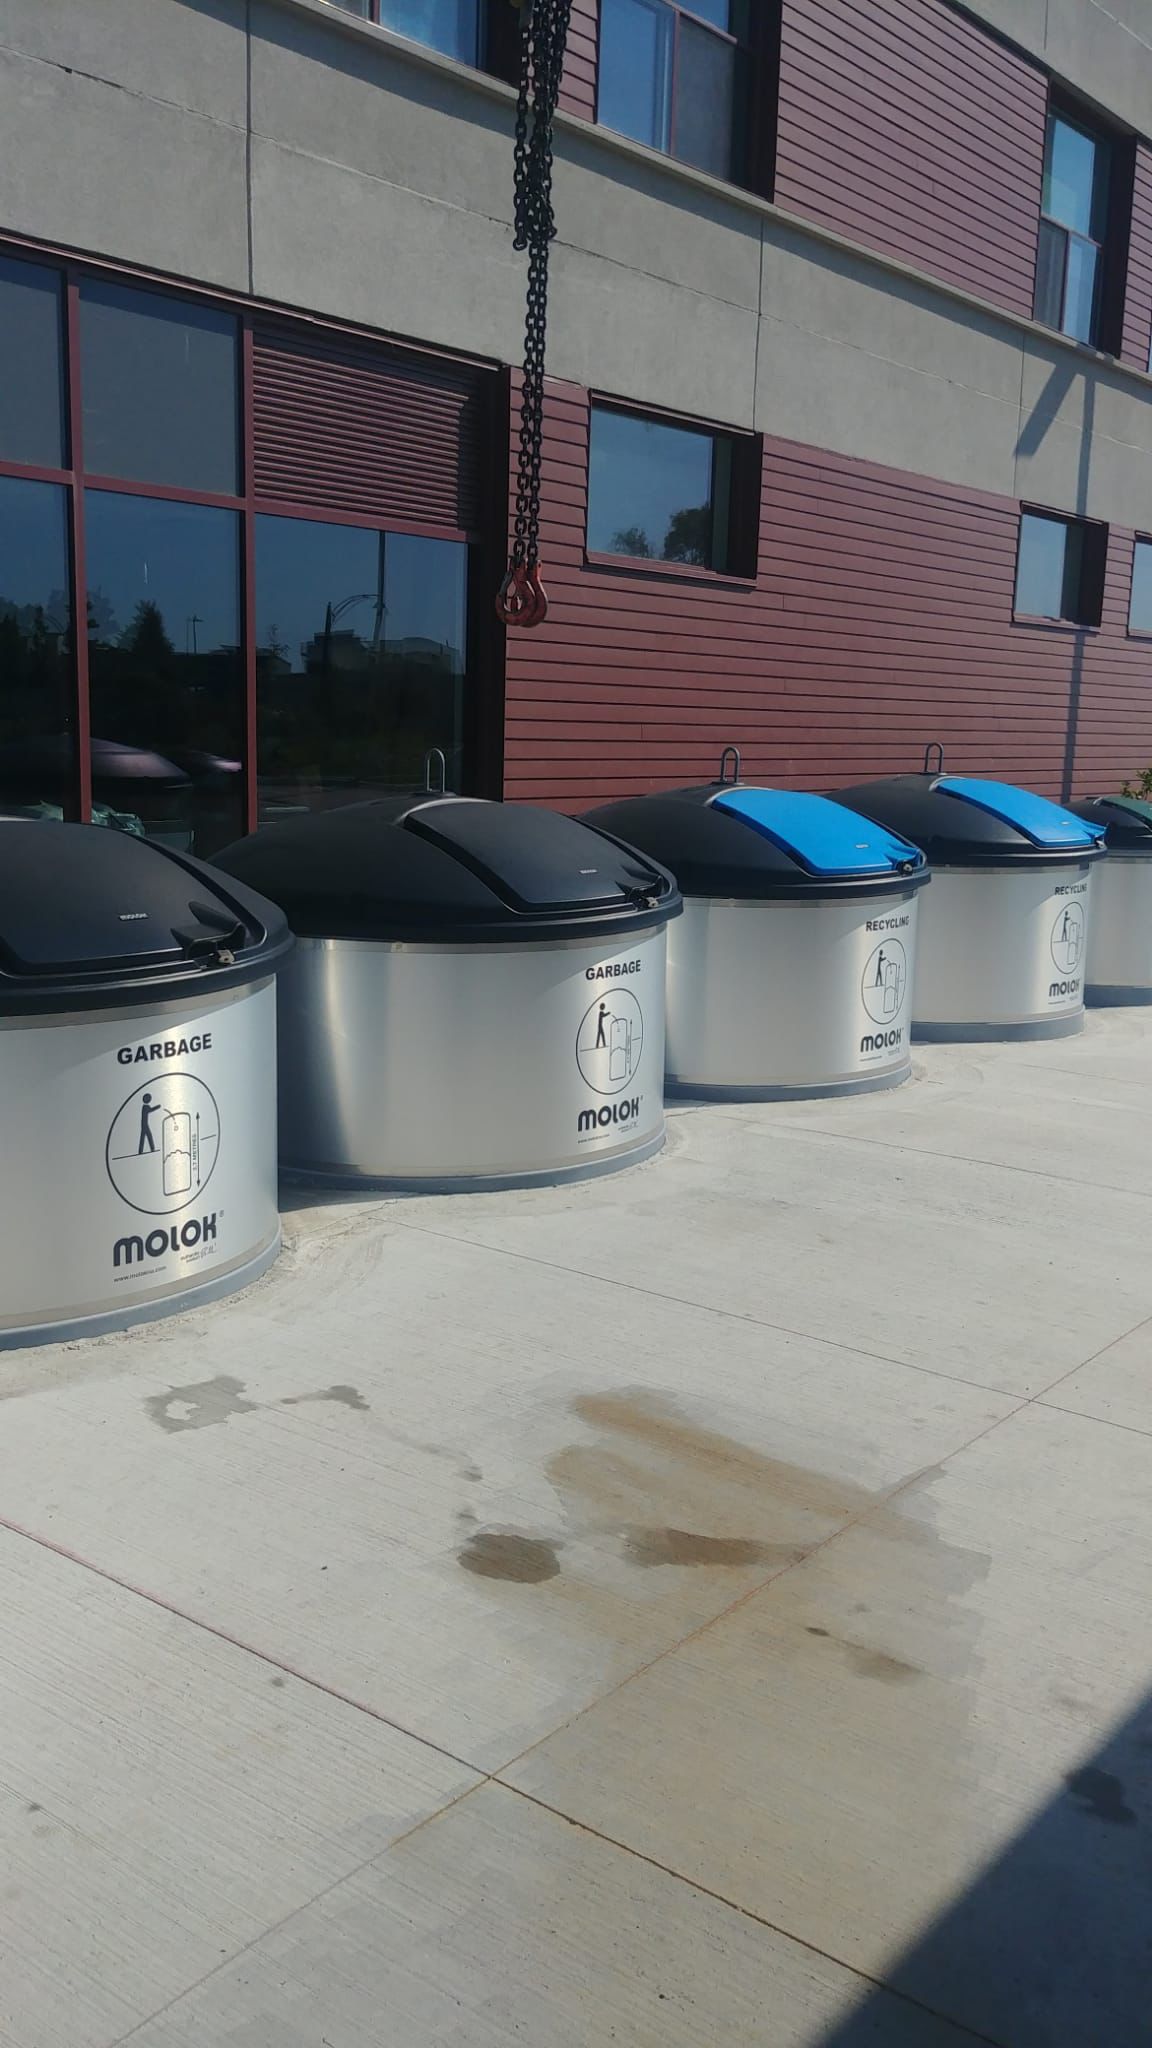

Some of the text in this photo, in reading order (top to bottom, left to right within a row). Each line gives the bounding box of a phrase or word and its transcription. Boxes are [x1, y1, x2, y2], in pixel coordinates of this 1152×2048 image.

[865, 916, 909, 932] RECYCLING
[585, 960, 641, 981] GARBAGE
[117, 1033, 212, 1065] GARBAGE
[861, 1028, 902, 1053] MOLOK
[578, 1096, 640, 1132] MOLOK
[113, 1212, 217, 1267] MOLOK
